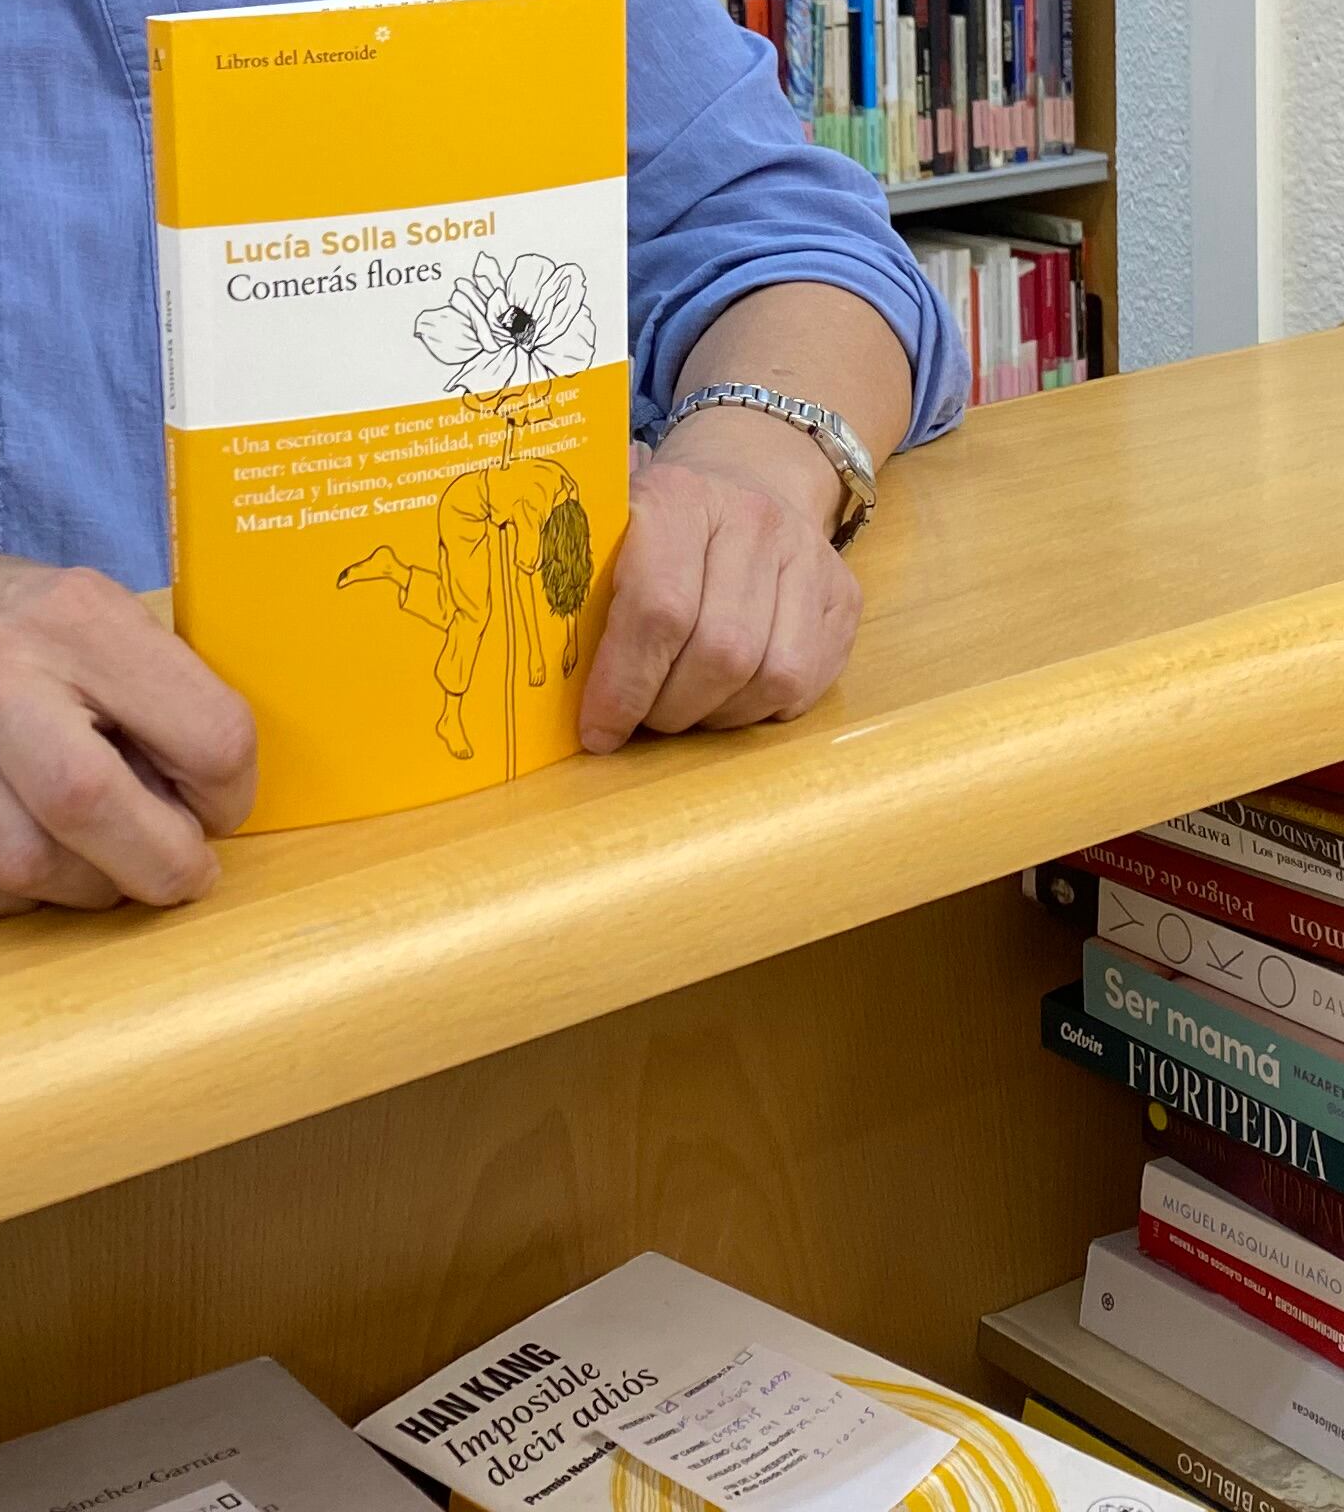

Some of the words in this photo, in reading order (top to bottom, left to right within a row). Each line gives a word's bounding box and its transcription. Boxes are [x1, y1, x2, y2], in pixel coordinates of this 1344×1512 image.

[216, 53, 269, 70] Libros
[274, 50, 298, 67] del
[303, 44, 377, 65] Asteroide
[225, 234, 311, 264] Lucía
[322, 226, 396, 255] Solla
[407, 211, 496, 246] Sobral
[227, 265, 357, 302] Comerás
[367, 259, 442, 289] flores
[233, 463, 286, 482] tener:
[291, 452, 353, 476] técnica
[358, 453, 369, 471] y
[373, 436, 474, 465] sensibilidad,
[477, 426, 513, 448] rigor
[529, 410, 587, 435] frescura,
[276, 426, 353, 451] escritora
[358, 422, 390, 444] que
[394, 417, 434, 437] tiene
[438, 410, 475, 430] todo
[555, 387, 580, 409] que
[232, 484, 305, 509] crudeza
[310, 483, 321, 502] y
[326, 473, 394, 497] lirismo,
[396, 454, 502, 486] conocimiento
[236, 509, 293, 533] Marta
[299, 501, 369, 529] Jiménez
[373, 491, 438, 516] Serrano
[1159, 869, 1183, 890] de
[1252, 843, 1274, 859] Los
[1276, 851, 1333, 880] pasajeros
[1187, 879, 1256, 922] Peligro
[1060, 1021, 1105, 1057] Colvin
[1104, 968, 1160, 1026] Ser
[1167, 1007, 1281, 1088] mamá
[1127, 1040, 1328, 1182] FLORIPEDIA
[1162, 1195, 1217, 1233] MIGUEL
[1219, 1222, 1290, 1269] PASQUAU
[1294, 1259, 1343, 1295] LIAÑO
[395, 1392, 481, 1446] HAN
[460, 1342, 562, 1404] KANG
[441, 1362, 601, 1469] Imposible
[486, 1420, 568, 1488] decir
[572, 1367, 660, 1430] adiós
[523, 1471, 571, 1507] Premio
[569, 1447, 608, 1477] Nobel
[1177, 1453, 1255, 1512] BÍBLICO
